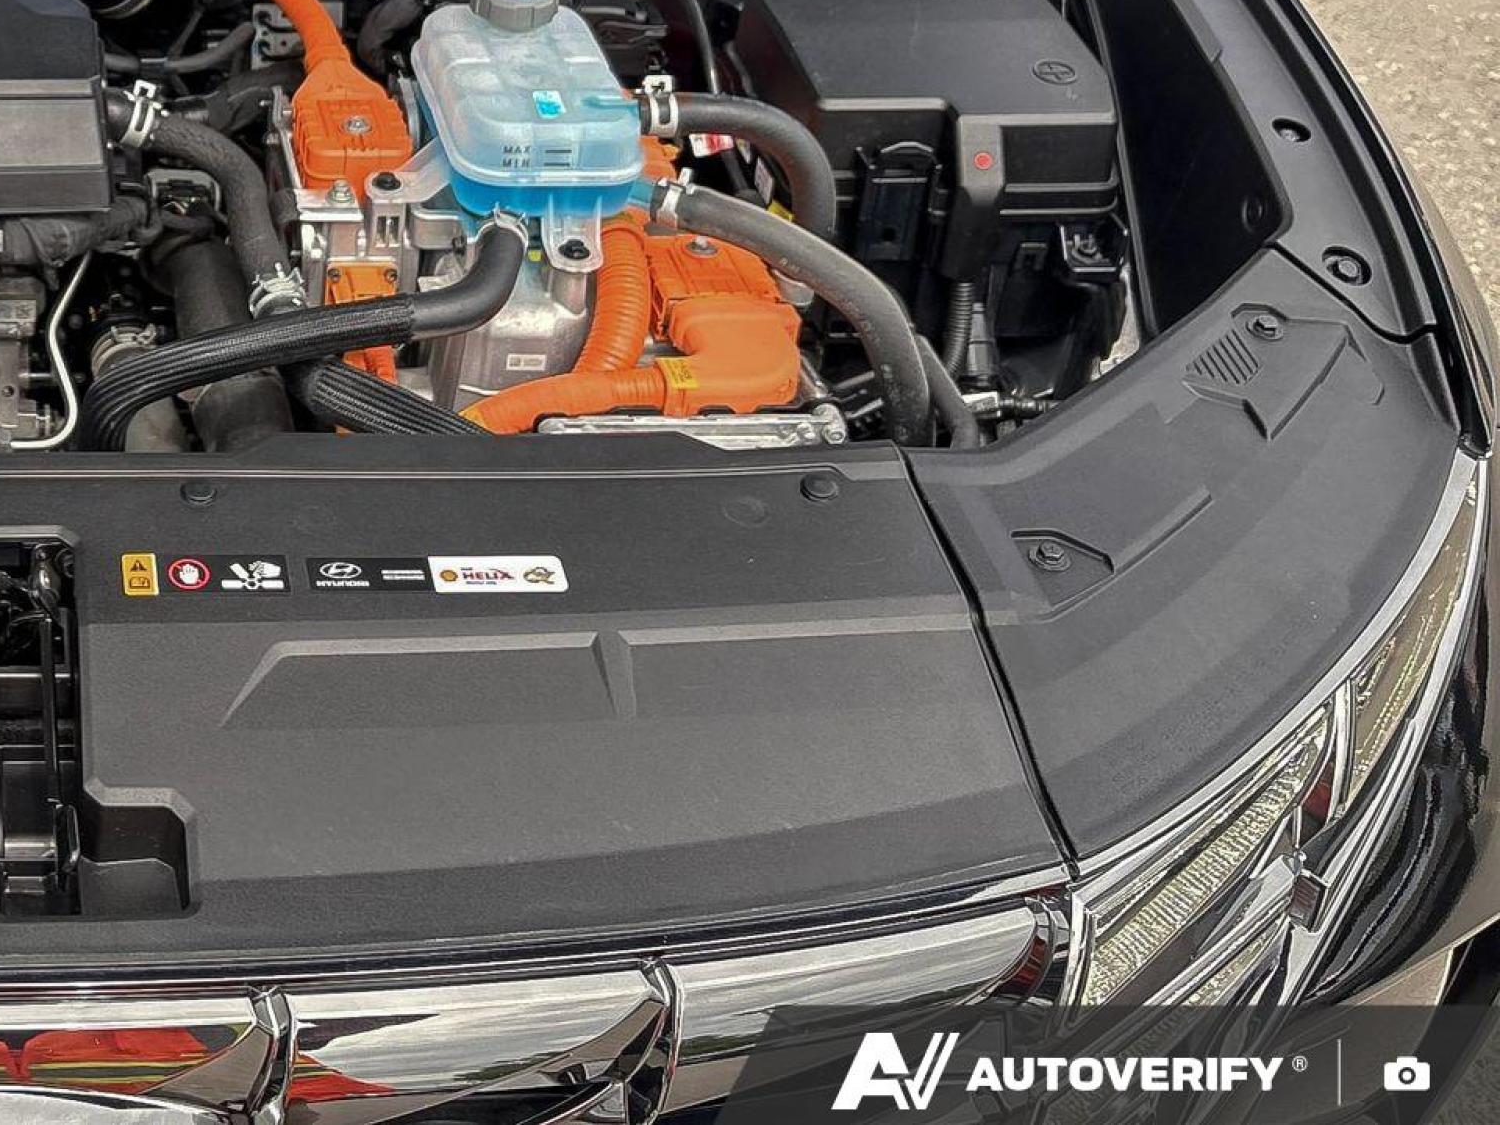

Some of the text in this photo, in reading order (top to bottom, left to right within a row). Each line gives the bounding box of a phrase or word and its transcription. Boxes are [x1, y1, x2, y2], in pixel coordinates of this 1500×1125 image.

[502, 145, 531, 154] MAX
[502, 158, 531, 169] MIN
[462, 569, 514, 580] HELIX
